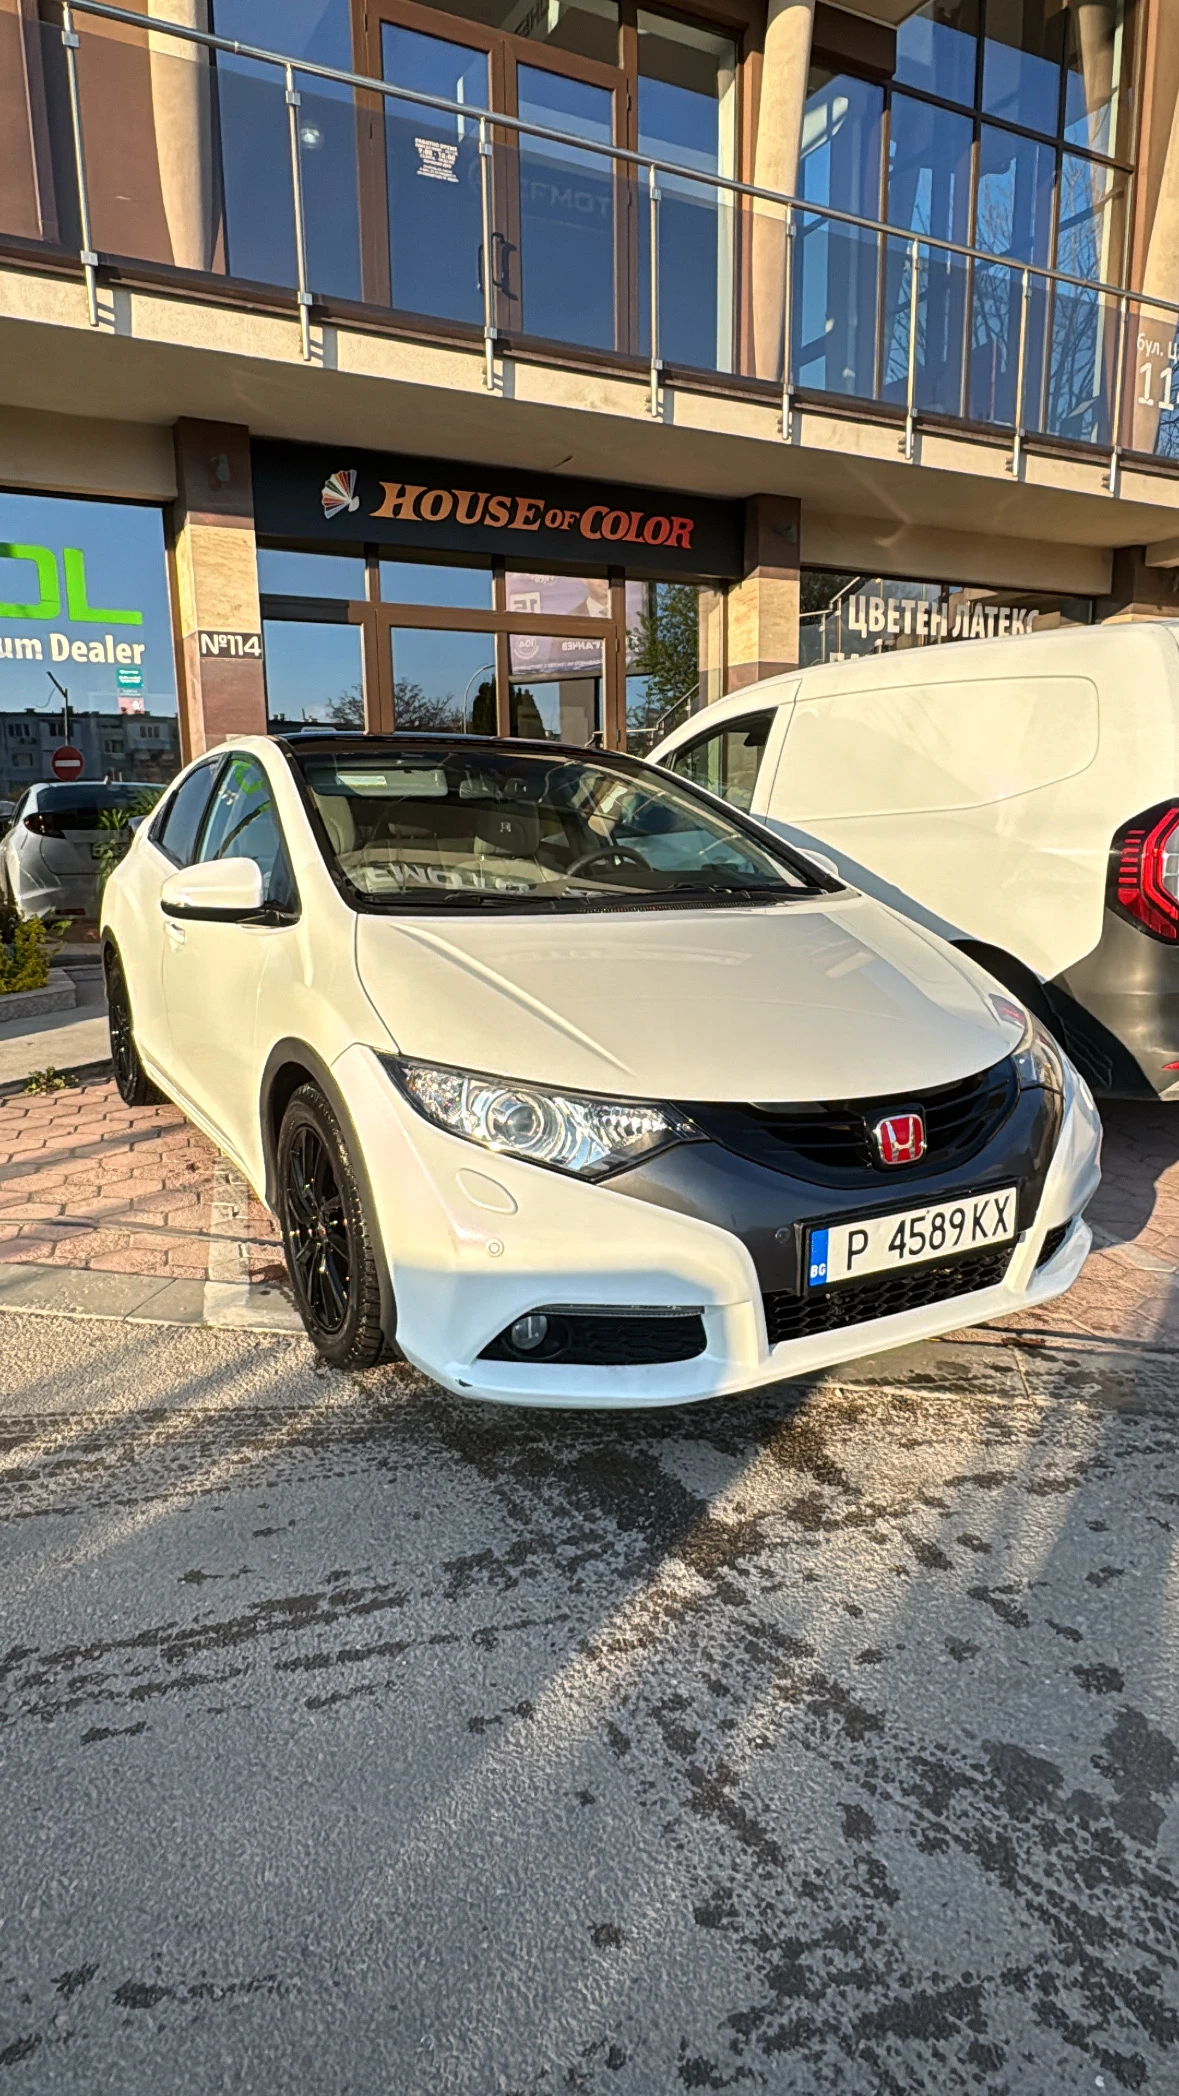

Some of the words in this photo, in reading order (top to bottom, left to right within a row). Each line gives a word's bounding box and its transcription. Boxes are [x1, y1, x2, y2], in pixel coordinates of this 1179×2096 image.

[1137, 332, 1163, 357] бул.
[1138, 362, 1179, 411] 11
[369, 481, 545, 531] HOUSE
[545, 508, 580, 530] OF
[579, 505, 695, 549] COLOR
[848, 594, 948, 638] ЦВЕТЕН
[49, 632, 146, 665] Dealer
[810, 1263, 827, 1279] BG
